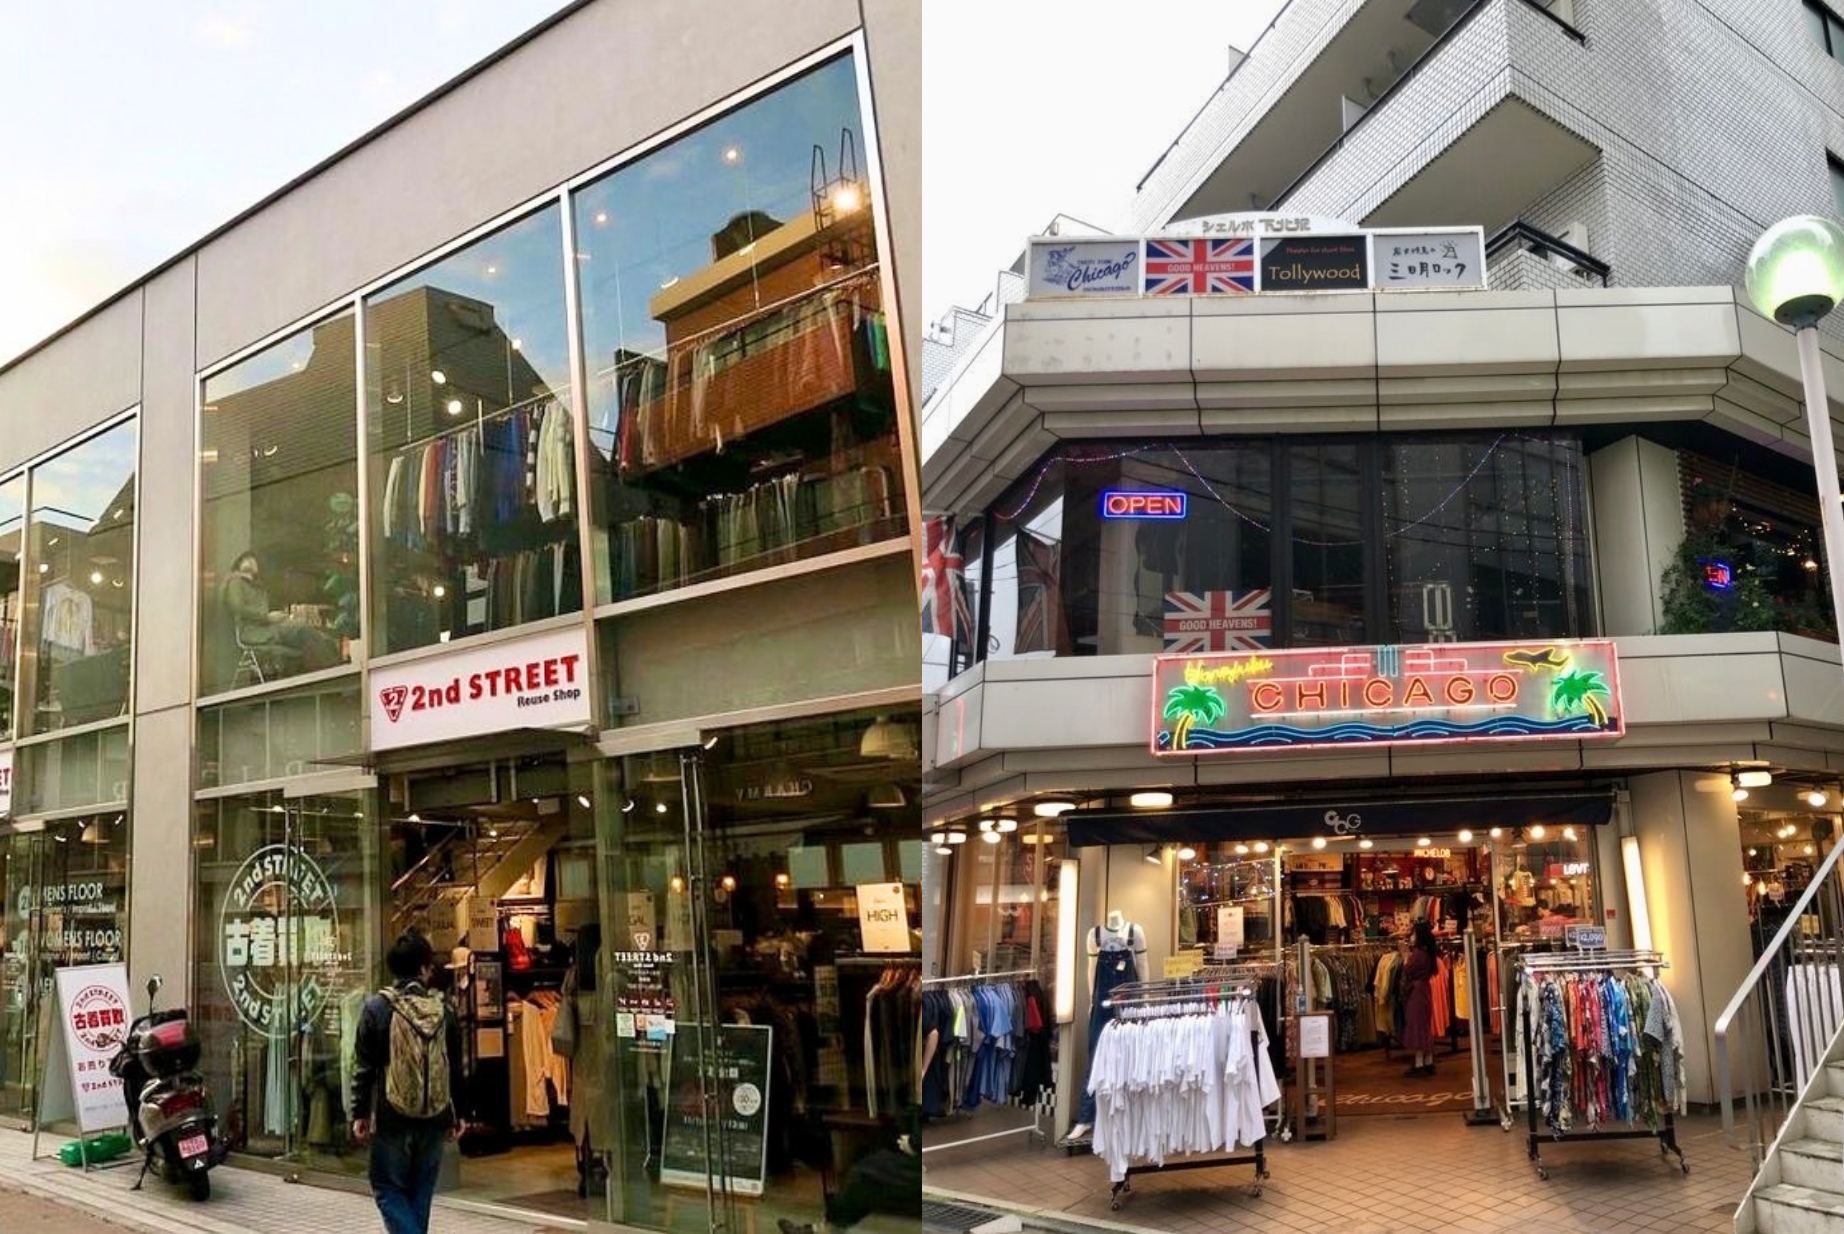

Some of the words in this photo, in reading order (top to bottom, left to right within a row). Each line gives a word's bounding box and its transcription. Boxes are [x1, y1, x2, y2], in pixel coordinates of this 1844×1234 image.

[1067, 252, 1137, 291] Chicago
[1167, 263, 1191, 273] GOOD
[1193, 262, 1235, 272] HEAVENS!
[1268, 264, 1361, 284] Tollywood
[1388, 261, 1467, 280] 三日月ロック
[1108, 496, 1182, 515] OPEN
[1707, 566, 1728, 584] EN
[1179, 619, 1207, 631] GOOD
[1209, 617, 1258, 630] HEAVENS!
[411, 677, 462, 711] 2nd
[468, 654, 579, 700] STREET
[516, 693, 550, 708] Reuse
[552, 686, 581, 705] Shop
[1252, 673, 1519, 712] CHICAGO
[68, 882, 103, 900] FLOOR
[234, 868, 263, 908] 2nd
[867, 909, 899, 922] HIGH
[85, 930, 121, 947] FLOOR
[232, 973, 259, 1020] 2nd
[74, 1008, 125, 1031] 古着買取
